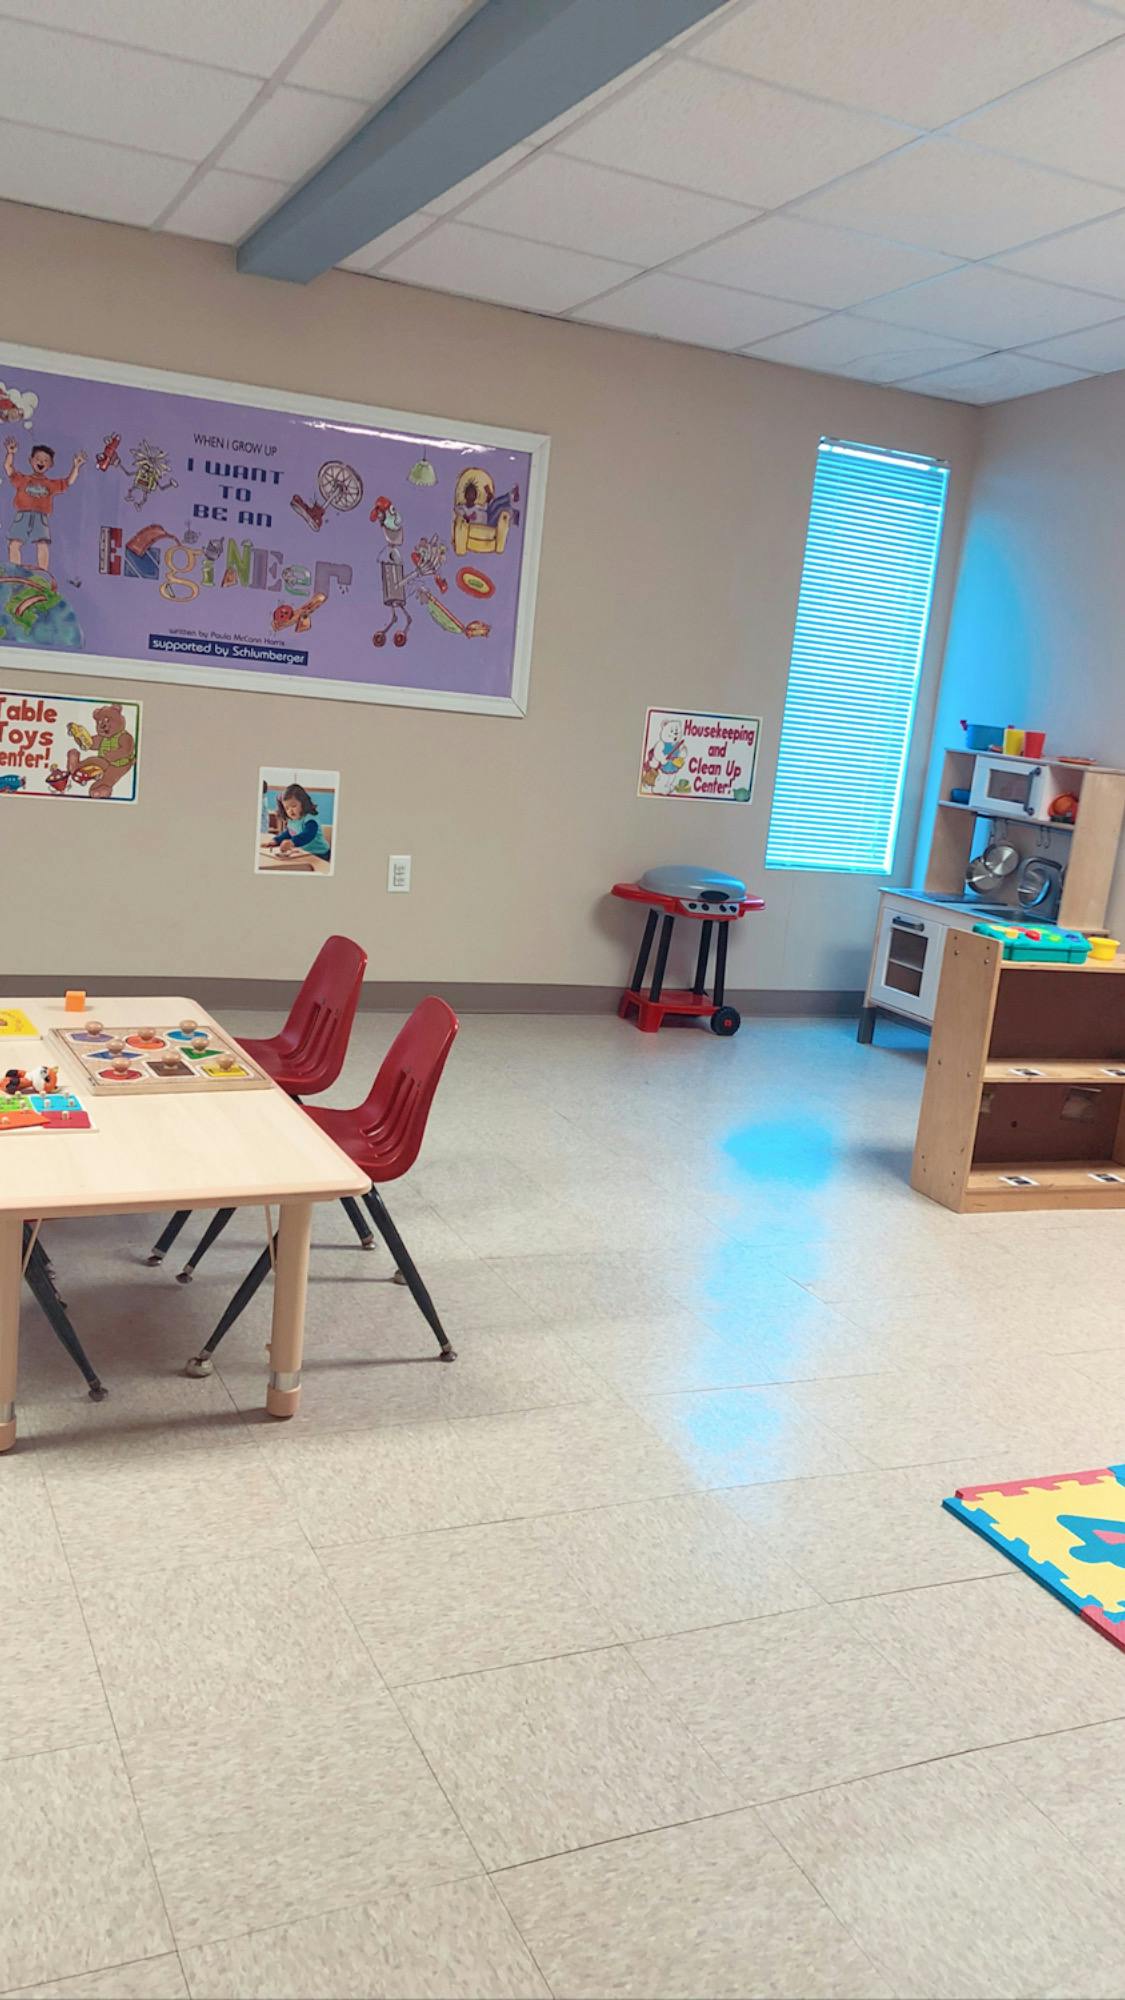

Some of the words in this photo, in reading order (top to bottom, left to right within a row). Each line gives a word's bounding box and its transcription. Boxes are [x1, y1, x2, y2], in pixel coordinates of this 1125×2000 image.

[193, 433, 224, 449] WHEN
[226, 439, 230, 450] I
[232, 440, 263, 454] GROW
[264, 445, 278, 457] UP
[187, 458, 194, 472] I
[205, 460, 285, 484] WANT
[219, 484, 251, 502] TO
[193, 503, 228, 522] BE
[238, 510, 272, 528] AN
[198, 629, 208, 639] by
[210, 631, 232, 640] Paula
[152, 639, 211, 656] supported
[215, 645, 229, 657] by
[232, 646, 305, 664] Schlumberger
[683, 719, 755, 746] Housekeeping
[0, 745, 50, 769] enter!
[708, 741, 728, 758] and
[688, 757, 721, 776] Clean
[726, 760, 742, 780] Up
[693, 776, 734, 795] Center!
